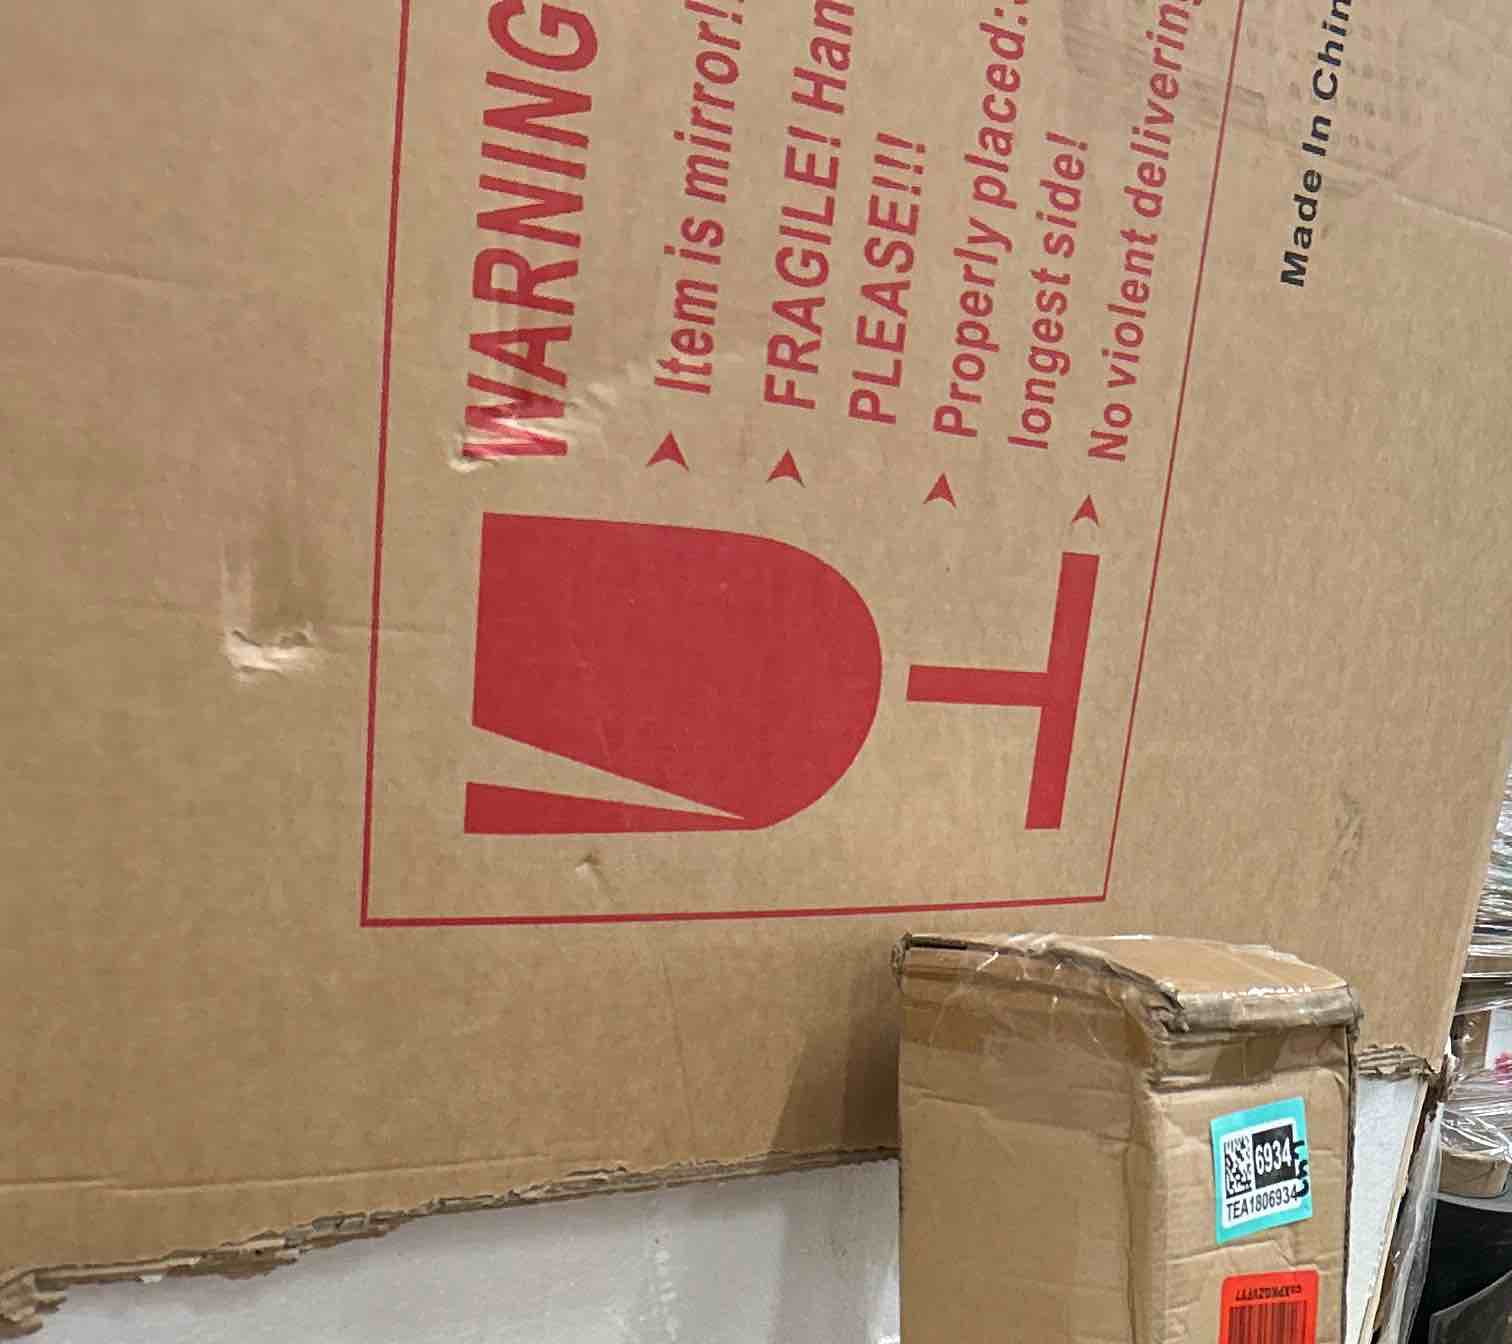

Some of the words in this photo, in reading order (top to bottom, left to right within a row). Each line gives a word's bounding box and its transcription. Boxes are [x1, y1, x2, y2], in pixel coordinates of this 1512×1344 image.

[673, 0, 744, 202] mirror!
[792, 0, 855, 114] Han
[1124, 0, 1200, 217] deliverin
[1312, 0, 1352, 101] Chin
[1036, 132, 1088, 258] side!
[1302, 114, 1332, 156] In
[462, 0, 598, 457] WARNING
[664, 216, 725, 265] is
[763, 126, 841, 409] FRAGILE!
[848, 133, 926, 424] PLEASE!!!
[1280, 169, 1322, 287] Made
[654, 278, 719, 394] Item
[933, 217, 1012, 437] Properly
[1008, 268, 1071, 449] longest
[1101, 228, 1158, 388] violent
[1088, 404, 1132, 462] No
[1226, 1184, 1298, 1221] TEA1806934
[1255, 1137, 1292, 1176] 6934
